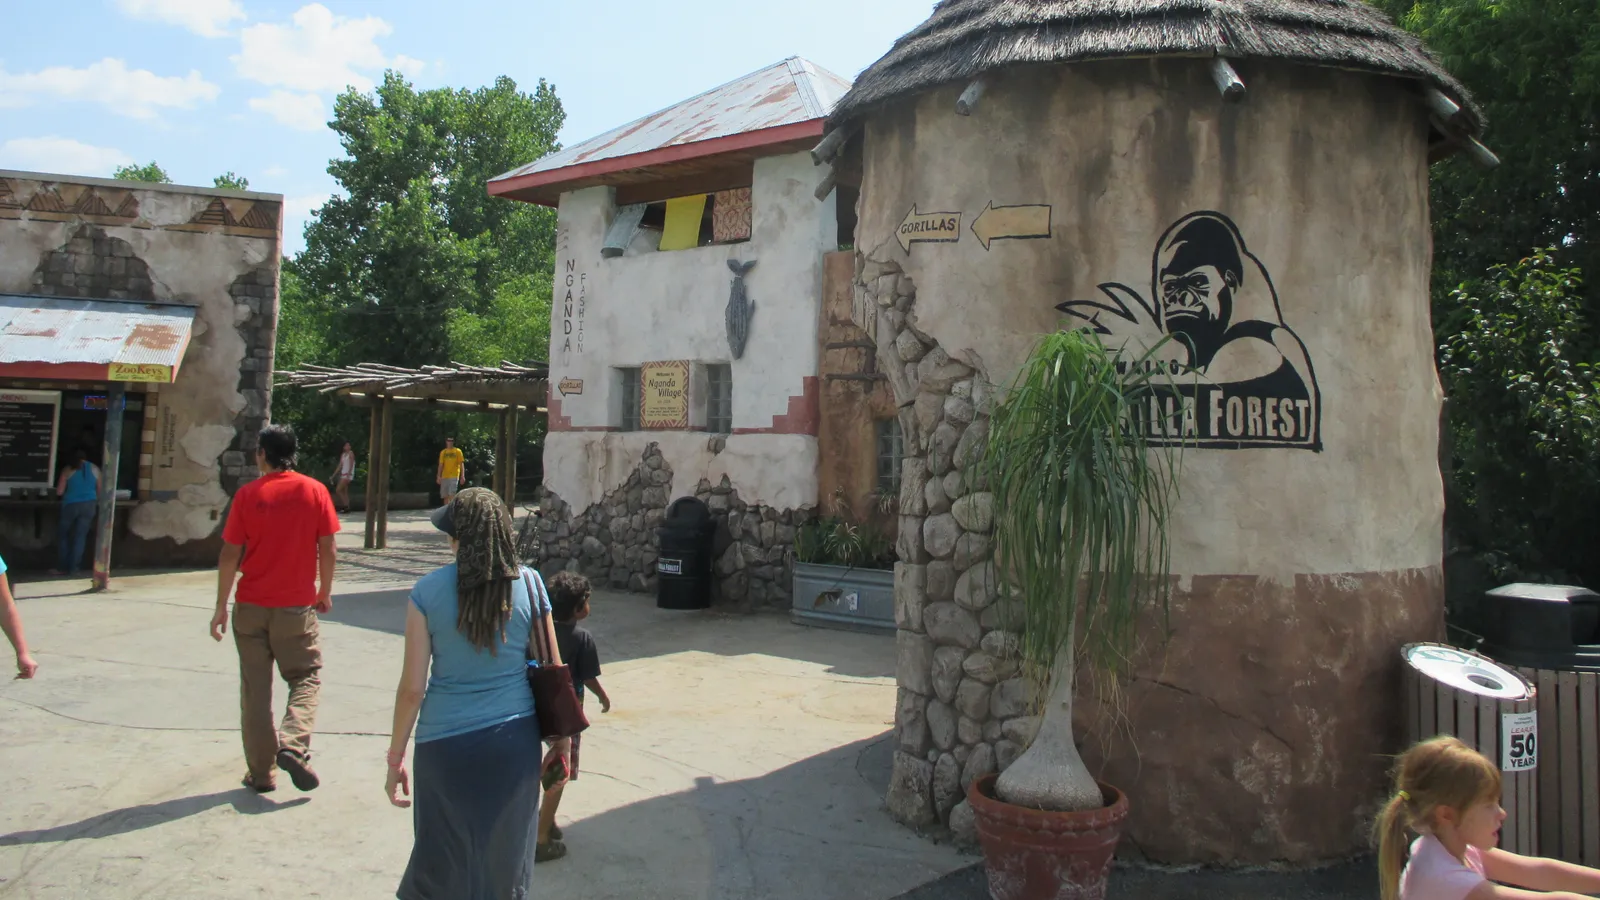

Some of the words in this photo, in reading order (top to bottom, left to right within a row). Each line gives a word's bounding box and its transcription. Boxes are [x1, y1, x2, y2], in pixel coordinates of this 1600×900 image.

[901, 218, 956, 234] GORILLAS
[577, 273, 586, 353] FASHION
[115, 364, 163, 375] ZooKeys
[648, 378, 676, 389] Nganda
[658, 388, 682, 399] Village
[1210, 390, 1310, 438] FOREST
[1510, 732, 1536, 757] 50
[1510, 756, 1536, 768] YEARS
